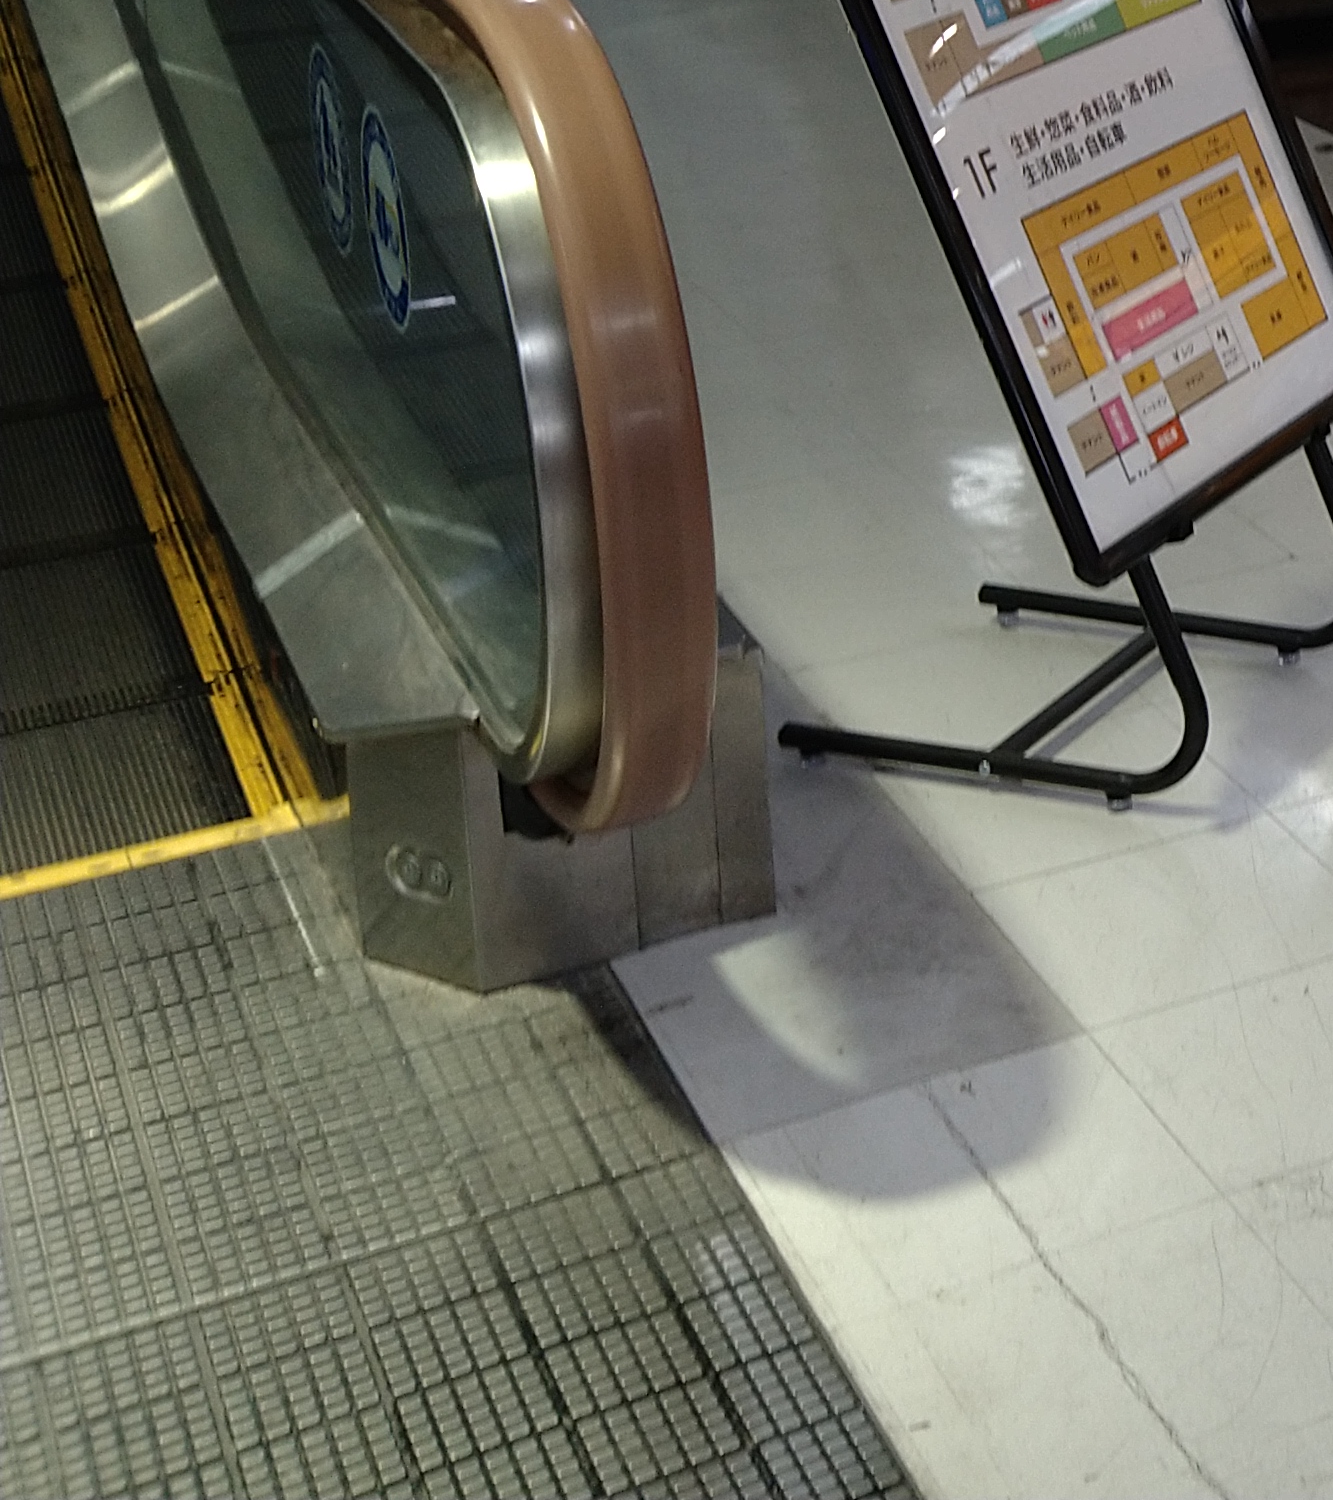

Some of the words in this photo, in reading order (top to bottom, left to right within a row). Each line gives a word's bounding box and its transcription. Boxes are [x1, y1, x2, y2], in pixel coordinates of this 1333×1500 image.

[963, 146, 998, 199] 1F
[1021, 120, 1129, 190] 生活用品・自転車
